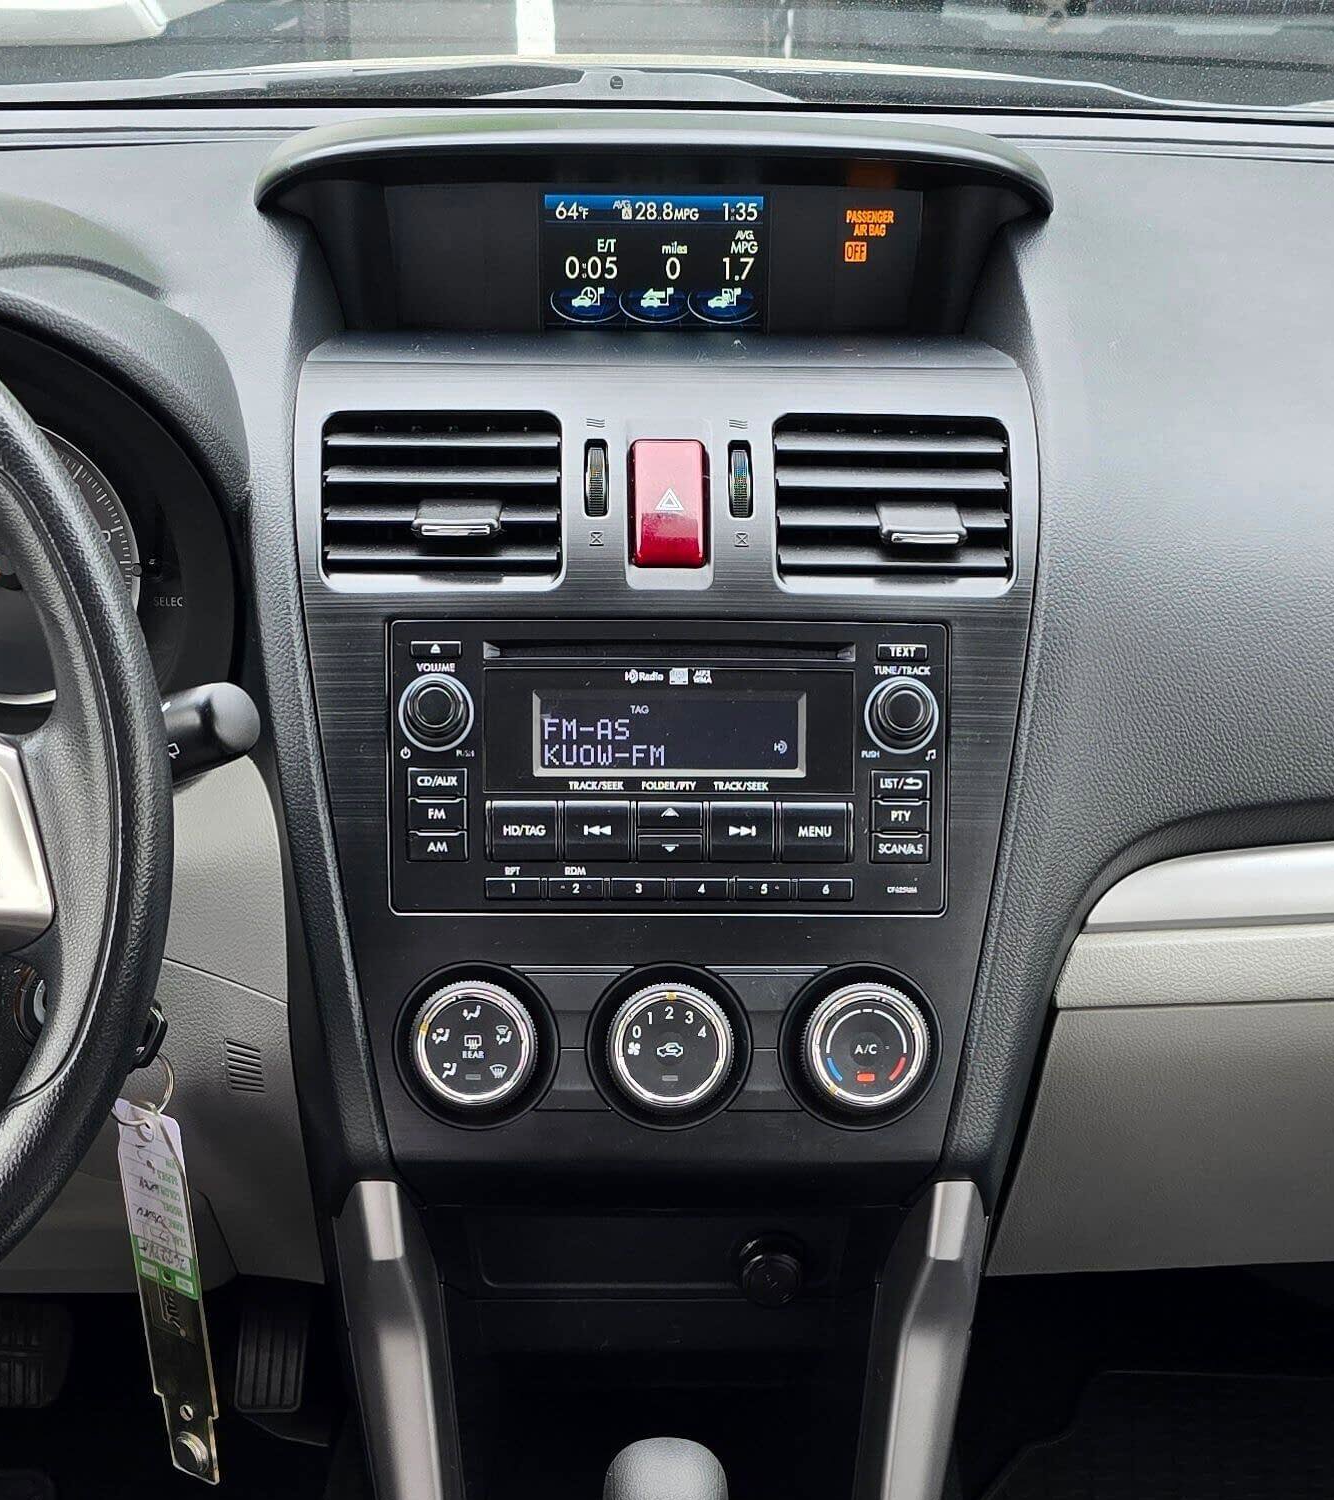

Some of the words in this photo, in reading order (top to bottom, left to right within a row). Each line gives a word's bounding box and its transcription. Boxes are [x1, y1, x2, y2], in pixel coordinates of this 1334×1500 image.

[722, 203, 758, 221] 1:35
[846, 209, 894, 223] PASSENGER
[597, 239, 616, 253] E/T
[662, 241, 687, 254] miles
[730, 241, 758, 254] MPG
[846, 244, 865, 260] OFF
[565, 256, 617, 279] 0:05
[665, 257, 680, 280] 0
[722, 257, 754, 280] 1.7
[889, 647, 916, 657] TEXT
[416, 662, 455, 672] VOLUME
[873, 665, 931, 675] TUNE/TRACK
[630, 705, 649, 714] TAG
[544, 718, 630, 740] FM-AS
[544, 744, 665, 766] KUOW-FM
[417, 776, 457, 787] CD/AUX
[569, 781, 624, 791] TRACK/SEEK
[642, 781, 696, 791] FOLDER/PTY
[714, 781, 768, 791] TRACK/SEEK
[428, 808, 446, 819] FM
[890, 811, 911, 821] PTY
[503, 825, 546, 837] HD/TAG
[798, 826, 832, 838] MENU
[427, 842, 448, 852] AM
[504, 867, 520, 876] RPT
[565, 867, 586, 876] RDM
[510, 884, 516, 893] 1
[572, 883, 579, 894] 2
[635, 884, 642, 894] 3
[698, 884, 706, 894] 4
[760, 884, 767, 894] 5
[822, 884, 829, 894] 6
[664, 1006, 674, 1019] 2
[685, 1011, 693, 1024] 3
[647, 1012, 653, 1025] 1
[632, 1025, 642, 1039] 0
[697, 1025, 707, 1038] 4
[462, 1050, 485, 1059] REAR
[854, 1044, 877, 1054] A/C
